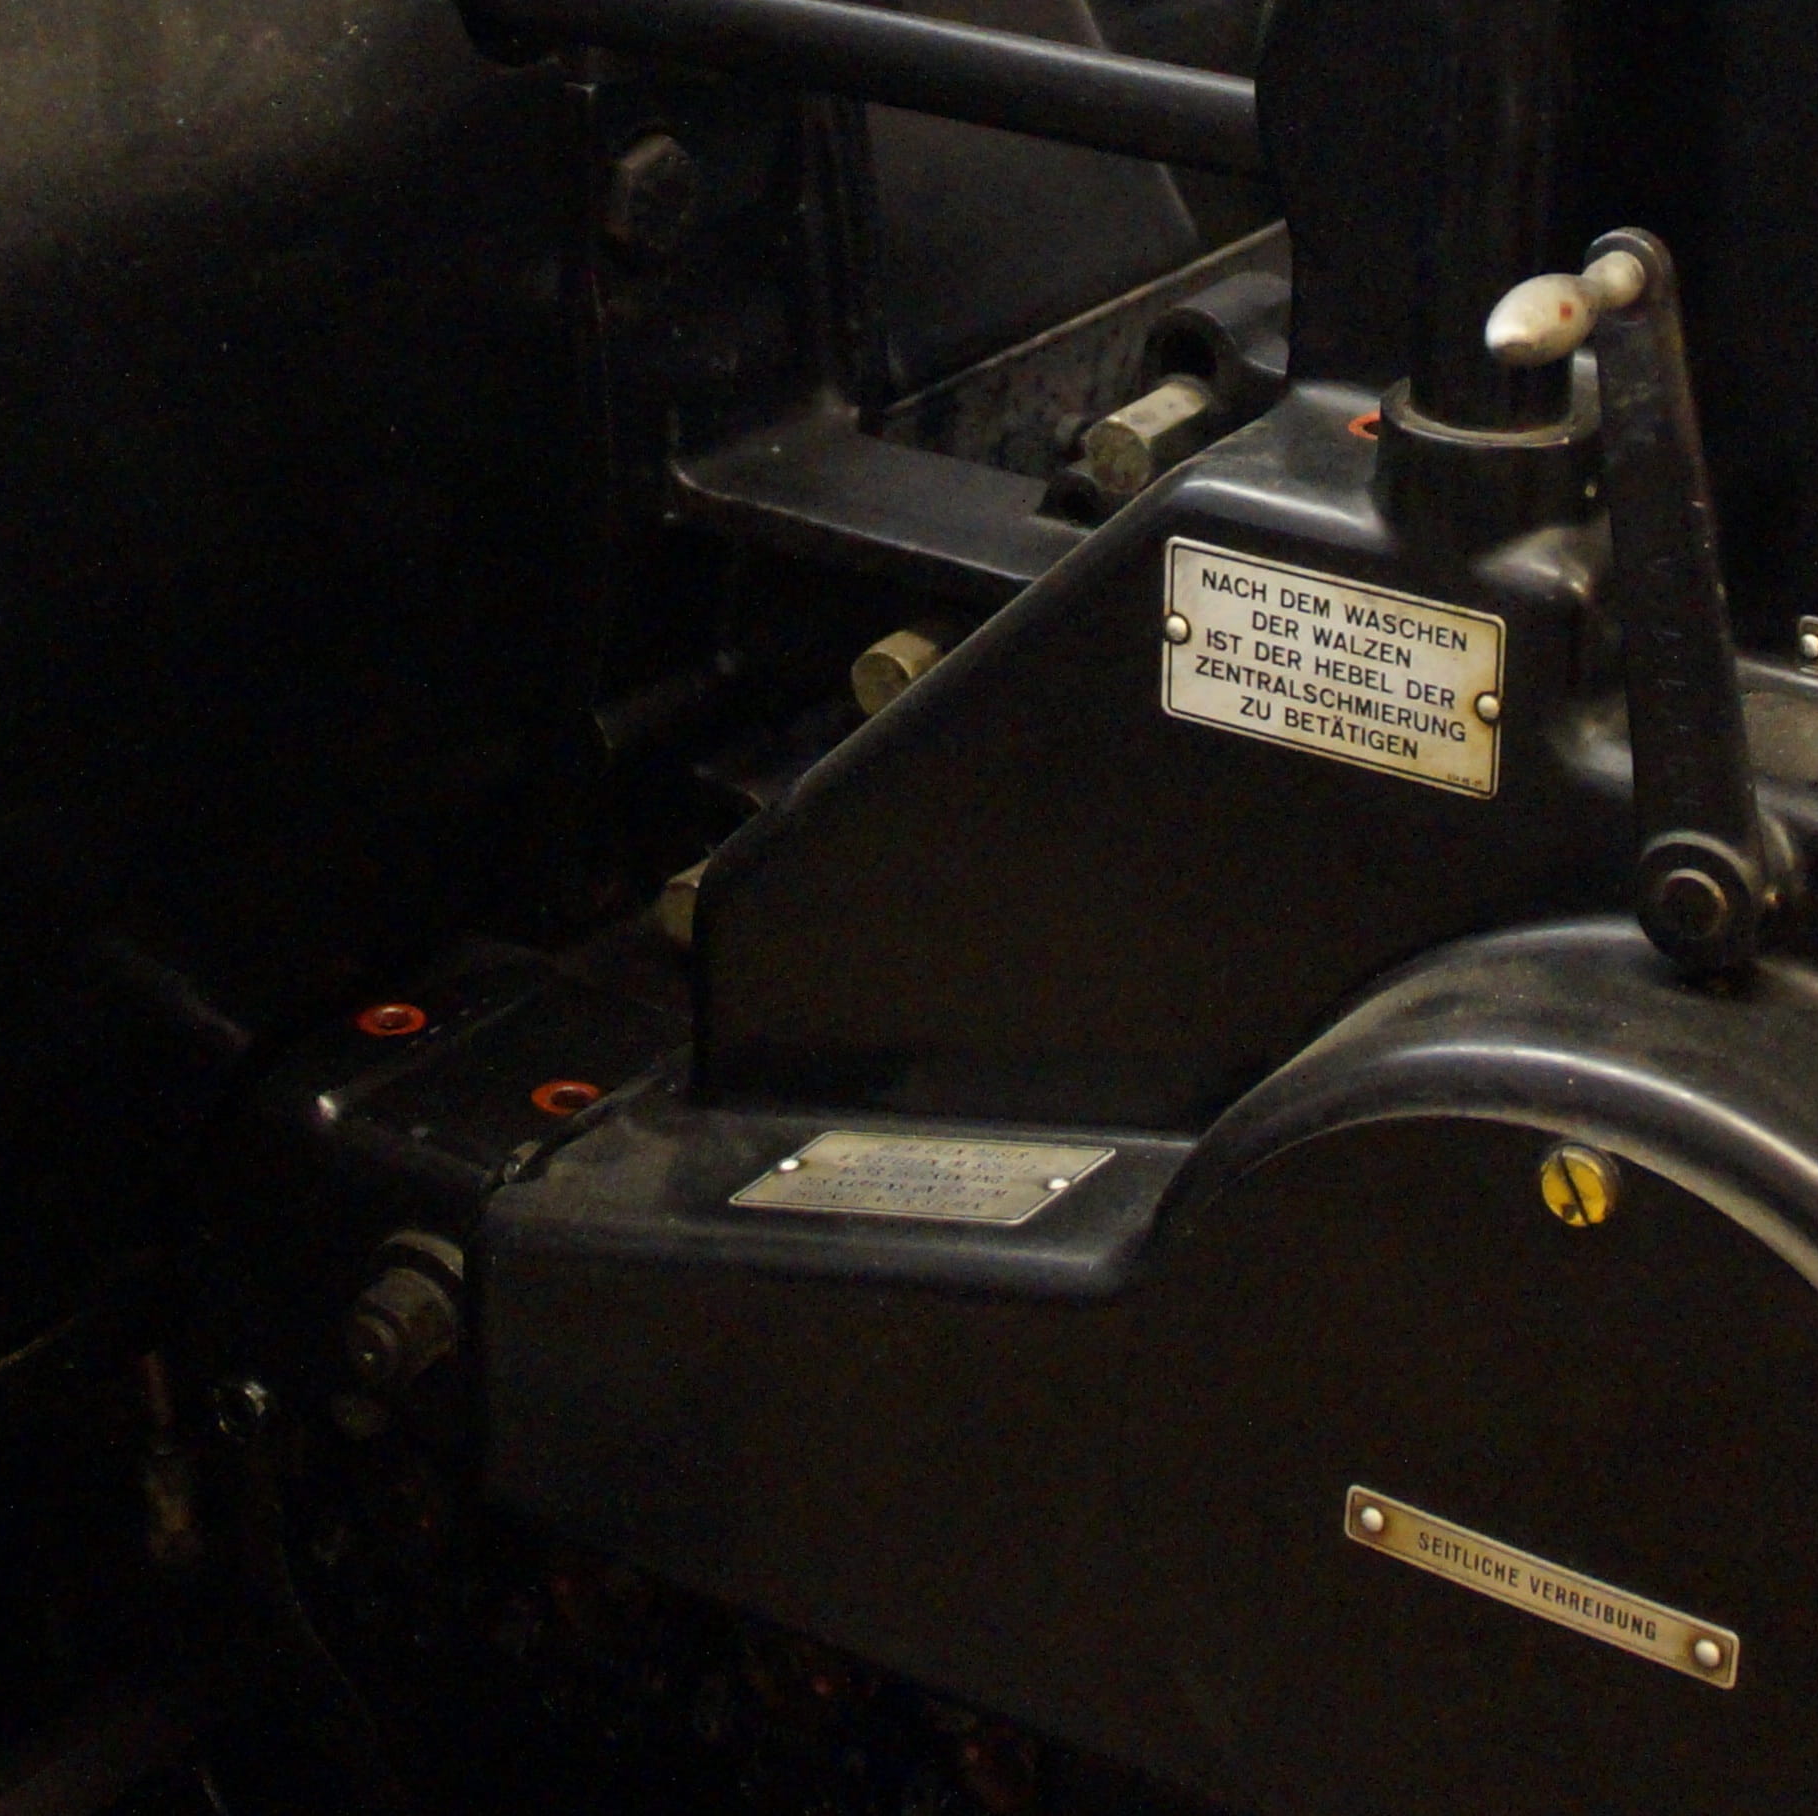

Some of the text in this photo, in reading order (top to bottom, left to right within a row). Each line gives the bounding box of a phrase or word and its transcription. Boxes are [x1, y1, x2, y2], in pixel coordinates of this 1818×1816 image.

[1201, 568, 1467, 652] NACH DEM WASCHEN
[1252, 610, 1412, 669] DER WALZEN
[1195, 655, 1467, 743] ZENTRALSCHMIERUNG
[1206, 628, 1455, 710] IST DER HEBEL DER
[1239, 695, 1418, 761] ZU BETÄTIGEN
[1418, 1531, 1657, 1641] SEITLICHE VERREIBUNG
